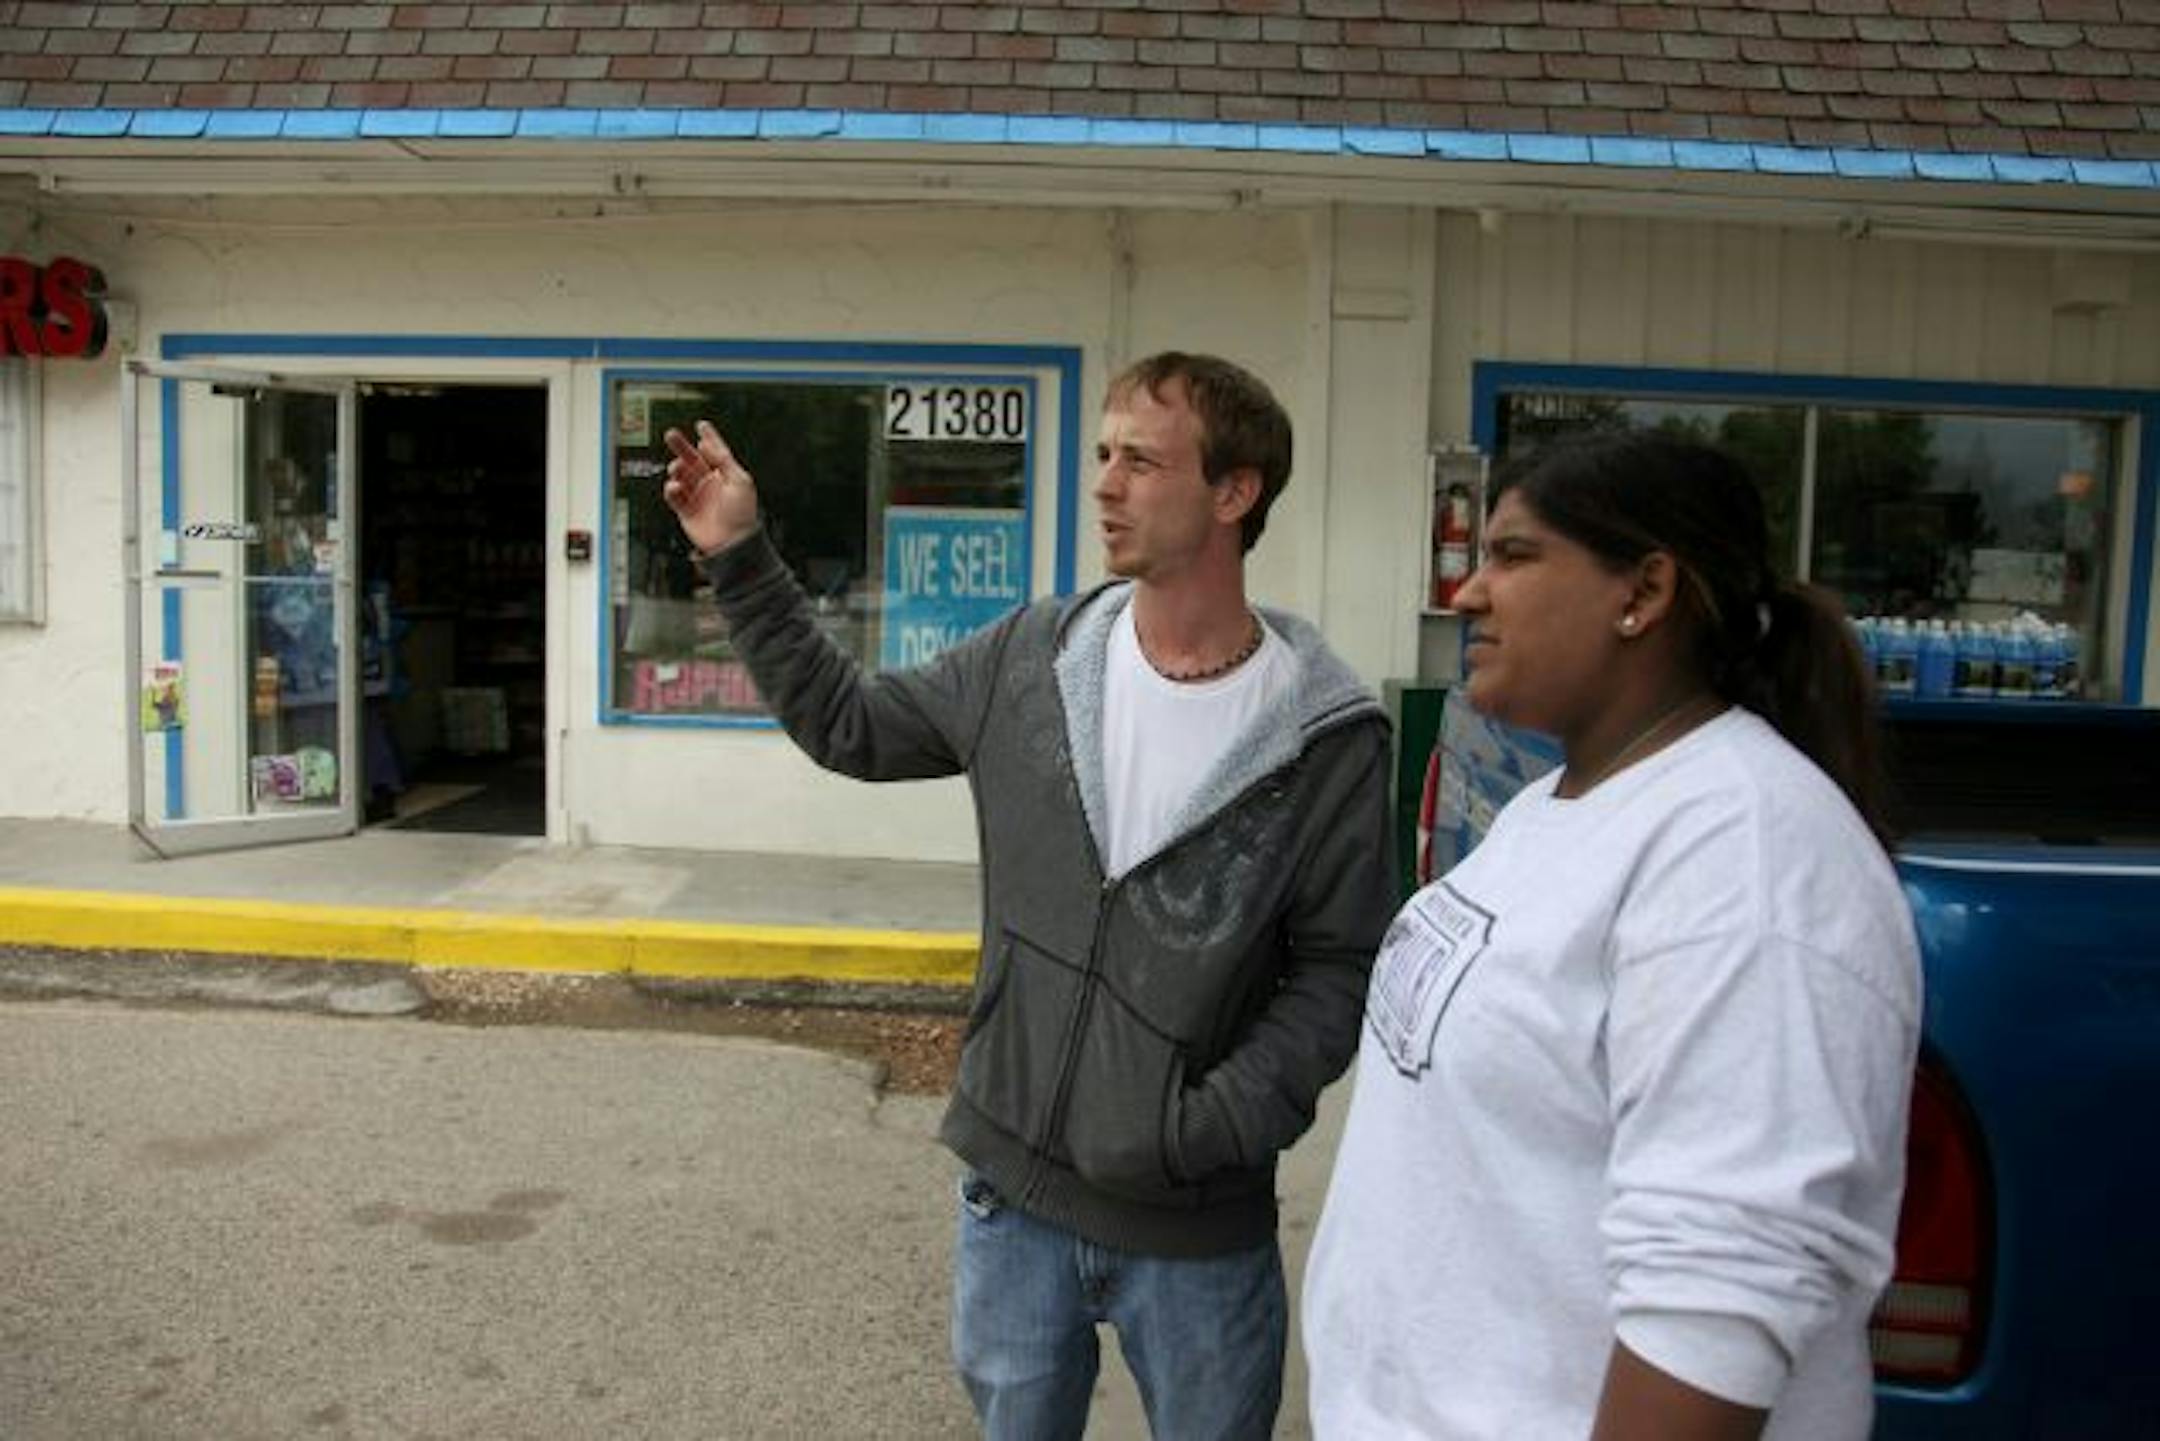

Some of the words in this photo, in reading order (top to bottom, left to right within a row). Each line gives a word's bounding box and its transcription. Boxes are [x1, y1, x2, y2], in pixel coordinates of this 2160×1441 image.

[890, 387, 1024, 437] 21380
[899, 532, 941, 597] WE
[950, 532, 1018, 599] SELL
